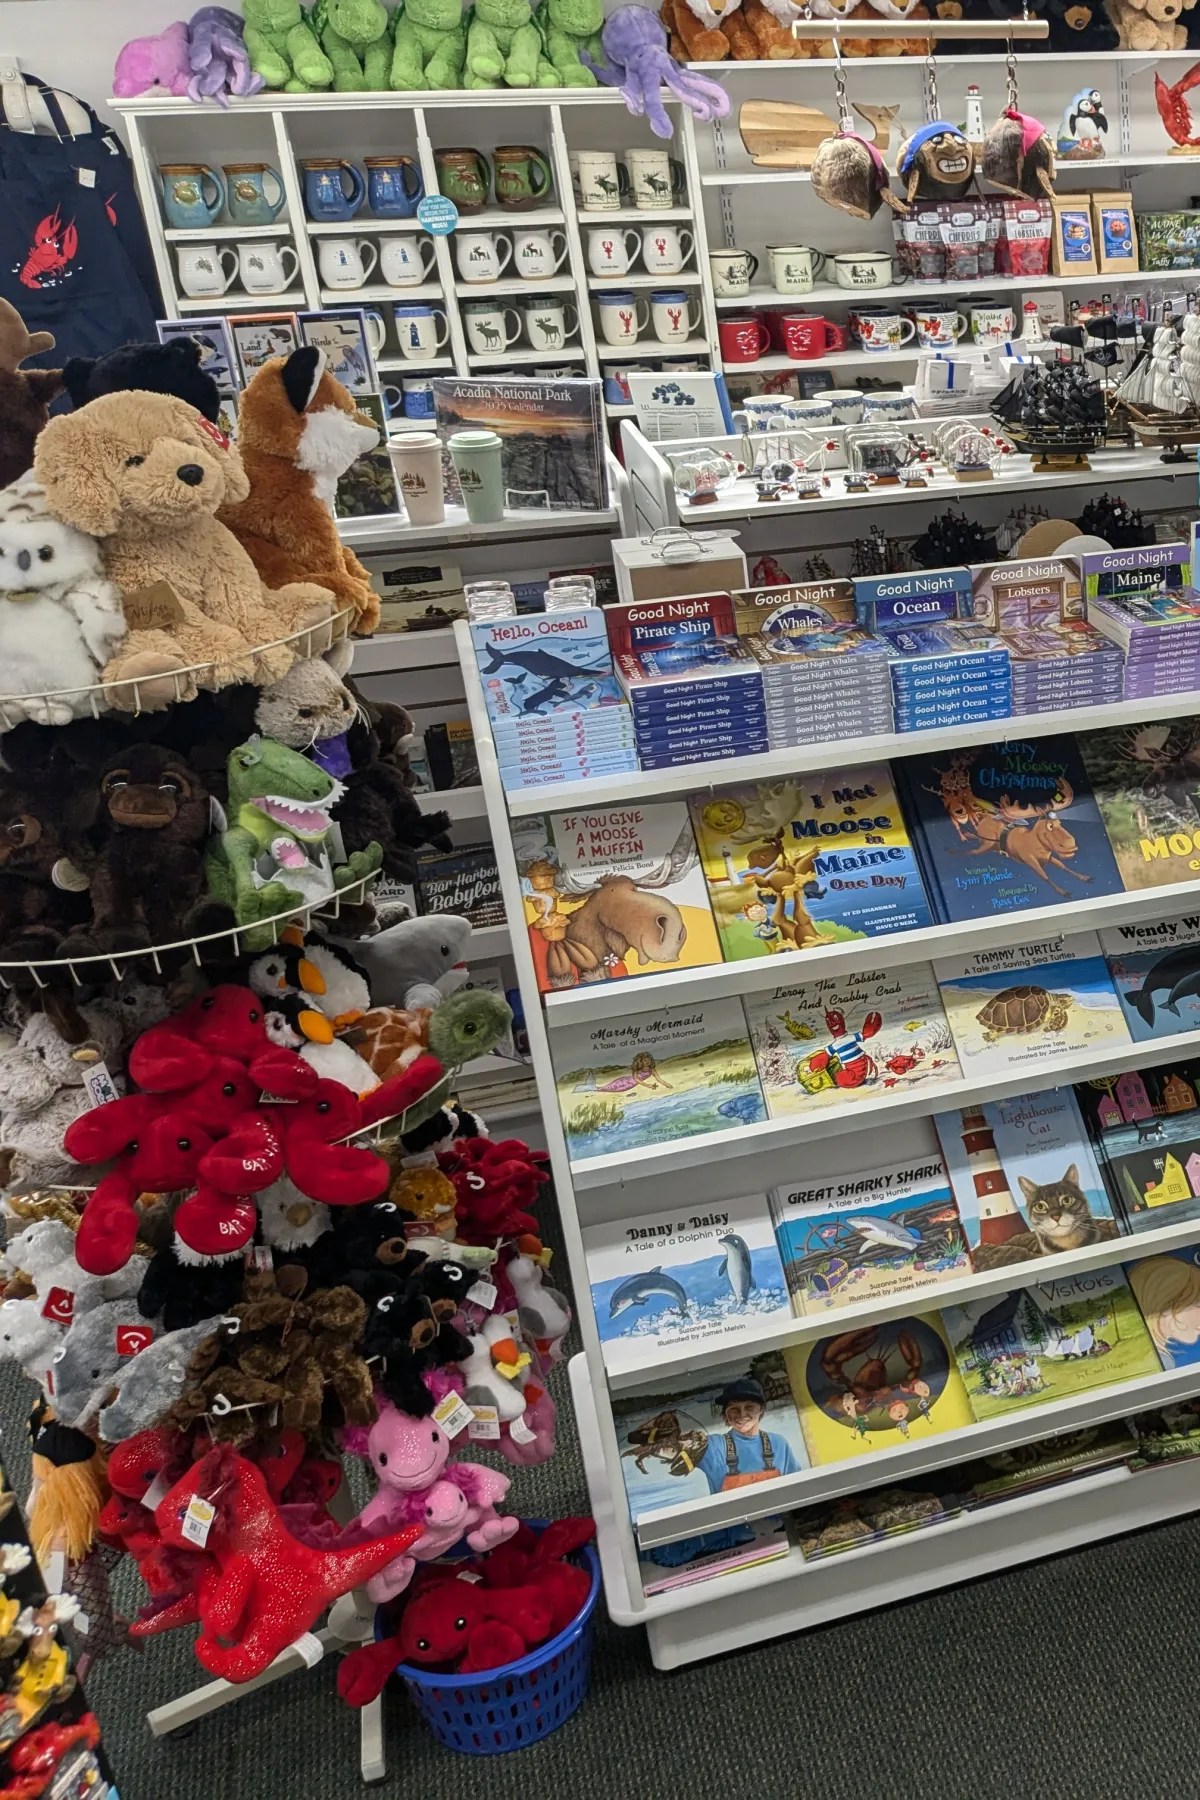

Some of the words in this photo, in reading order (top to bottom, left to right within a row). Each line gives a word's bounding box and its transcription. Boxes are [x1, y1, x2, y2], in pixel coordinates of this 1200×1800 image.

[1151, 220, 1181, 229] MAINE
[949, 231, 980, 242] CHERRIES
[240, 342, 261, 351] Land
[311, 337, 332, 346] Birds
[453, 386, 491, 399] Acadia
[495, 387, 541, 400] National
[546, 388, 572, 401] Park
[508, 402, 544, 412] Calendar
[1103, 554, 1134, 569] Good
[1138, 550, 1174, 567] Night
[991, 568, 1025, 582] Good
[1028, 562, 1064, 579] Night
[1117, 572, 1161, 587] Maine
[877, 581, 912, 597] Good
[916, 576, 955, 595] Night
[1007, 585, 1050, 598] Lobsters
[755, 593, 791, 607] Good
[795, 586, 836, 604] Night
[628, 607, 665, 622] Good
[668, 601, 710, 619] Night
[893, 600, 941, 615] Ocean
[491, 625, 535, 643] Hello,
[538, 616, 588, 635] Ocean!
[635, 623, 676, 640] Pirate
[679, 621, 710, 637] Ship
[777, 615, 823, 630] Whales
[912, 662, 933, 672] Good
[934, 659, 958, 671] Night
[960, 656, 985, 667] Ocean
[1005, 756, 1069, 777] Moosey
[523, 776, 541, 785] Hello,
[543, 773, 565, 783] Ocean!
[980, 767, 1057, 790] Christmas
[811, 794, 825, 809] I
[832, 784, 877, 804] Met
[563, 817, 578, 831] IF
[581, 814, 607, 828] YOU
[609, 811, 644, 826] GIVE
[791, 815, 892, 839] Moose
[576, 833, 585, 845] A
[590, 827, 638, 843] MOOSE
[577, 847, 586, 859] A
[592, 840, 644, 857] MUFFIN
[610, 855, 643, 865] Numeroff
[613, 865, 635, 873] Felicia
[636, 861, 654, 869] Bond
[813, 847, 906, 877] Maine
[830, 879, 868, 891] One
[870, 874, 907, 889] Day
[428, 880, 501, 912] Babylon
[1119, 921, 1178, 940] Wendy
[973, 949, 1015, 965] TAMMY
[1019, 941, 1062, 959] TURTLE
[798, 998, 823, 1012] And
[829, 990, 870, 1006] Crabby
[876, 983, 902, 997] Crab
[590, 1018, 641, 1042] Marshy
[645, 1013, 704, 1032] Mermaid
[999, 1102, 1067, 1129] Lighthouse
[1027, 1122, 1052, 1135] Cat
[787, 1187, 834, 1206] GREAT
[837, 1175, 893, 1198] SHARKY
[896, 1163, 943, 1185] SHARK
[626, 1224, 674, 1241] Danny
[677, 1221, 686, 1231] &
[689, 1211, 729, 1229] Daisy
[1038, 1272, 1114, 1303] Visitors
